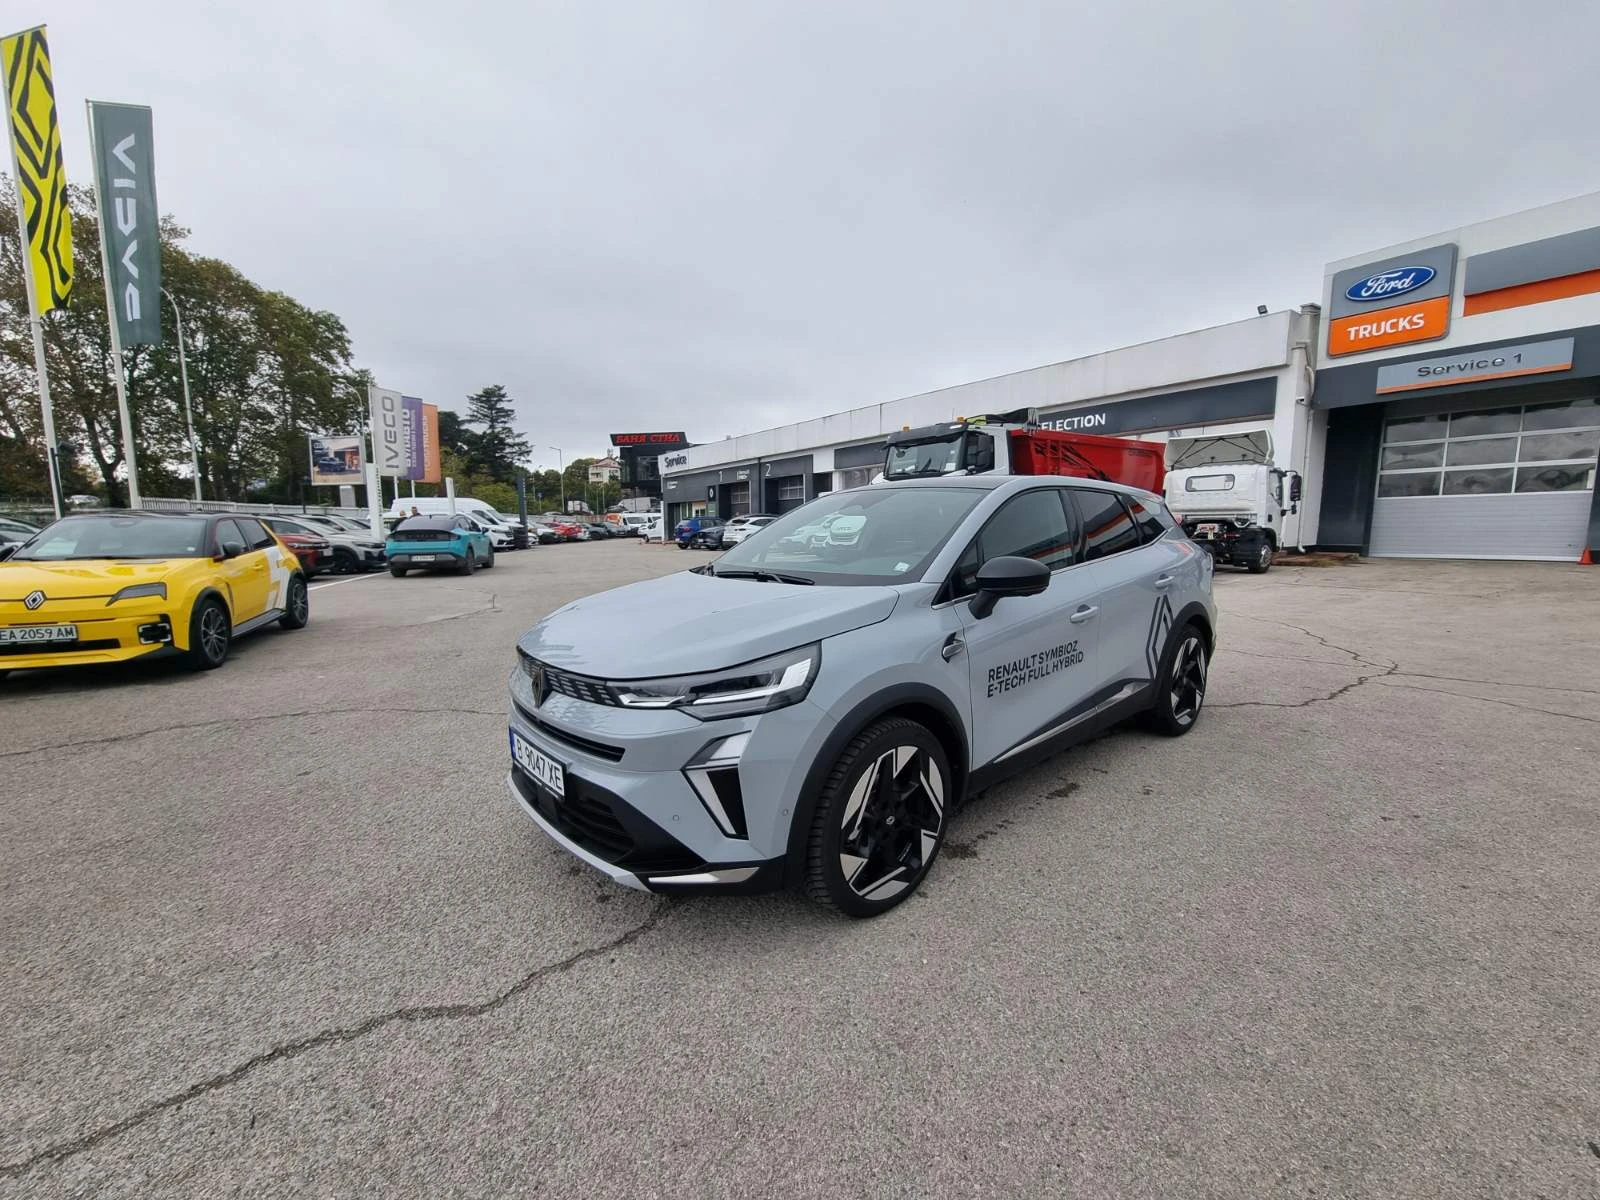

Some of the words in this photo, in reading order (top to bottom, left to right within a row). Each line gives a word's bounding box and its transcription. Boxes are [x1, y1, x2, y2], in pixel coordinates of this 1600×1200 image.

[112, 133, 141, 322] DACIA
[1361, 271, 1416, 297] Ford
[1347, 313, 1425, 341] TRUCKS
[1417, 357, 1505, 377] Service
[1513, 353, 1522, 363] 1
[382, 396, 399, 468] IVECO
[1038, 413, 1106, 431] ELECTION
[664, 454, 687, 468] Service
[764, 463, 772, 476] 2
[0, 630, 17, 640] EA
[20, 628, 53, 640] 2059
[57, 627, 75, 638] AM
[987, 672, 1026, 698] E-TECH
[1028, 664, 1050, 682] FULL
[1052, 651, 1084, 673] HYBRID
[988, 654, 1037, 683] RENAULT
[1038, 640, 1078, 664] SYMBIOZ
[516, 738, 523, 759] B
[525, 745, 546, 779] 9047
[548, 761, 564, 791] XE
